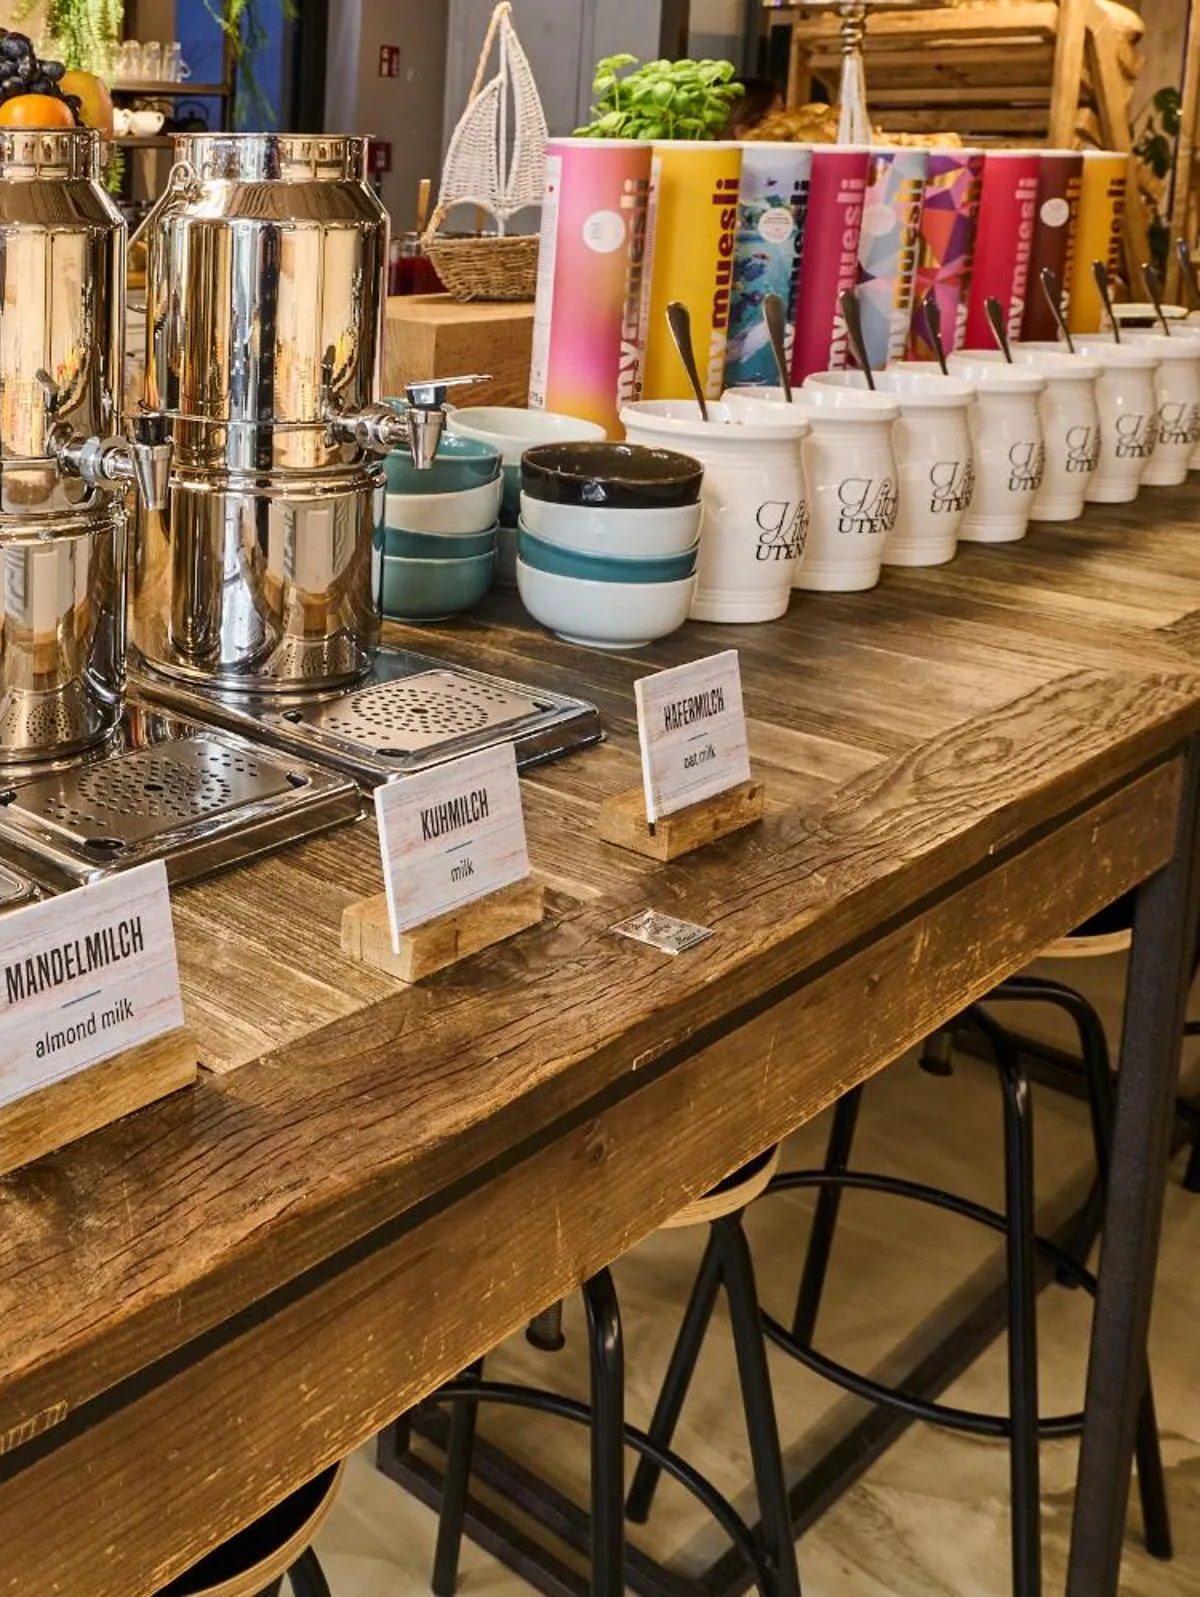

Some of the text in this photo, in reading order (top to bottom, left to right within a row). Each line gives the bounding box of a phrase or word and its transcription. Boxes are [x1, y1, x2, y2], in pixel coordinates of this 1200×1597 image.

[1006, 177, 1038, 342] mymuesli
[707, 178, 740, 400] mymuesli
[663, 687, 725, 732] HAFERMILCH
[684, 743, 717, 769] oat milk
[420, 787, 490, 841] KUHMILCH
[450, 857, 475, 883] milk
[5, 915, 145, 1005] MANDELMILCH
[35, 997, 135, 1059] almond milk
